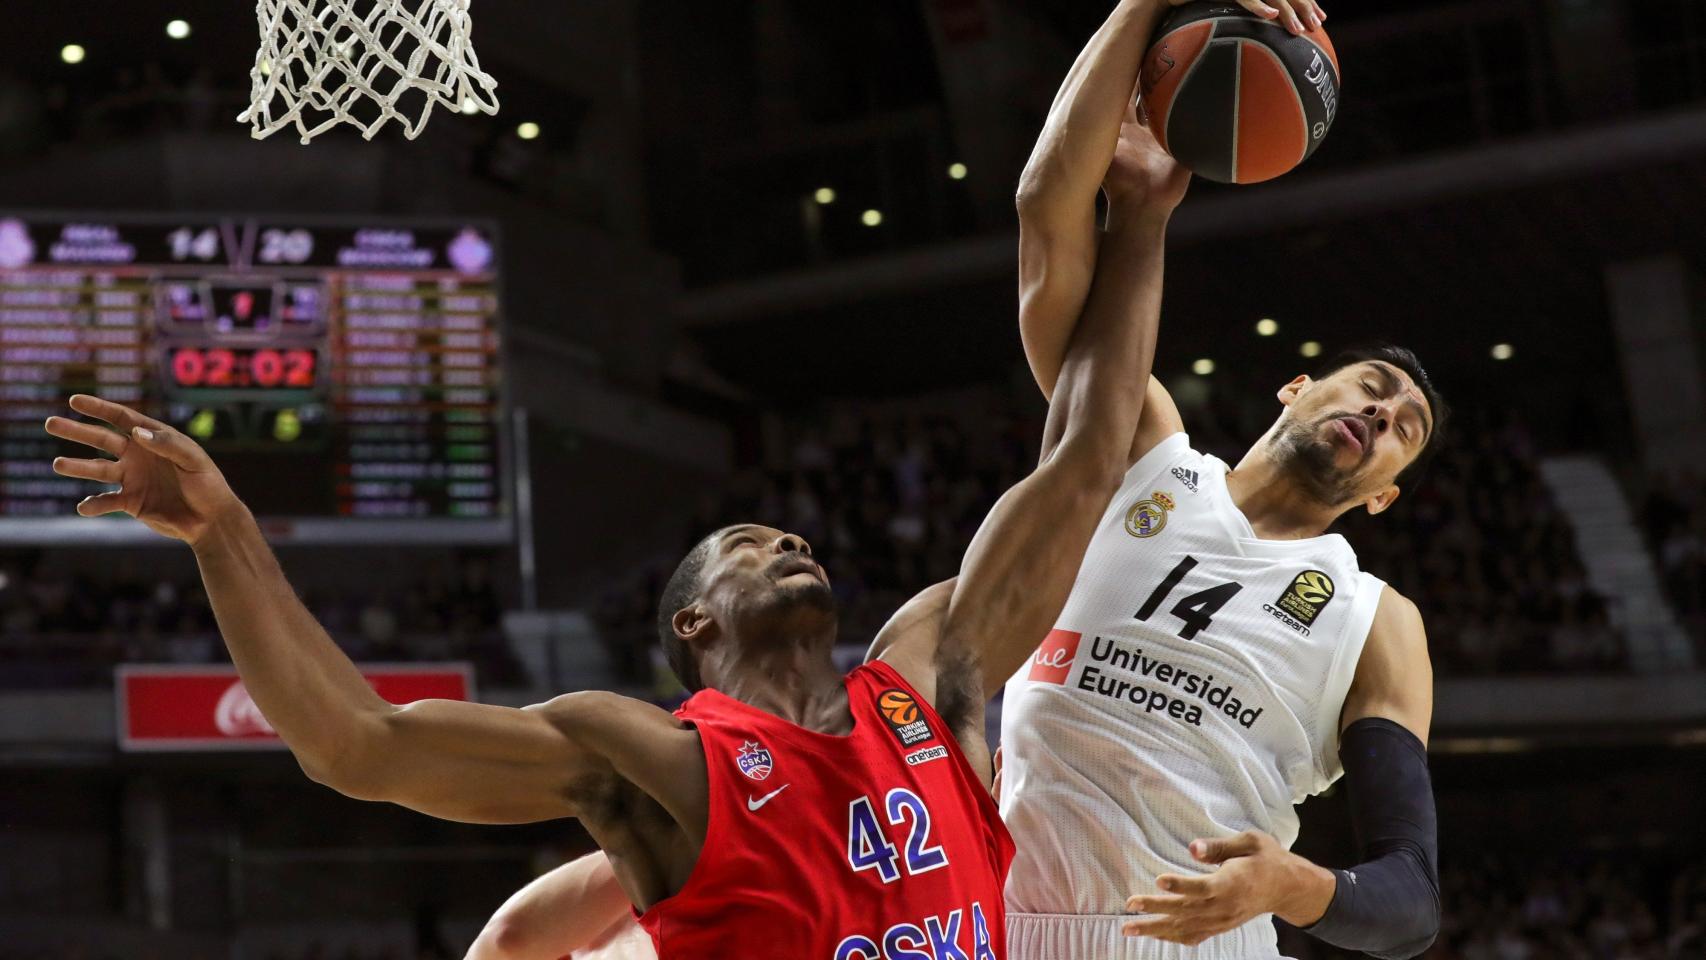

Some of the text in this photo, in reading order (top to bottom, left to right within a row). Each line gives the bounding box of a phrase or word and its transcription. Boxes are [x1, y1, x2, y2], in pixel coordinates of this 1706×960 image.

[169, 229, 218, 259] 14
[260, 228, 314, 264] 20
[172, 349, 315, 386] 02:02
[1171, 467, 1199, 494] adidas
[1133, 555, 1244, 641] 14
[1262, 603, 1311, 637] oneteam
[1077, 665, 1204, 727] Europea
[1090, 636, 1263, 729] Universidad
[740, 754, 769, 768] CSKA
[907, 747, 947, 764] oneteam
[848, 787, 949, 884] 42
